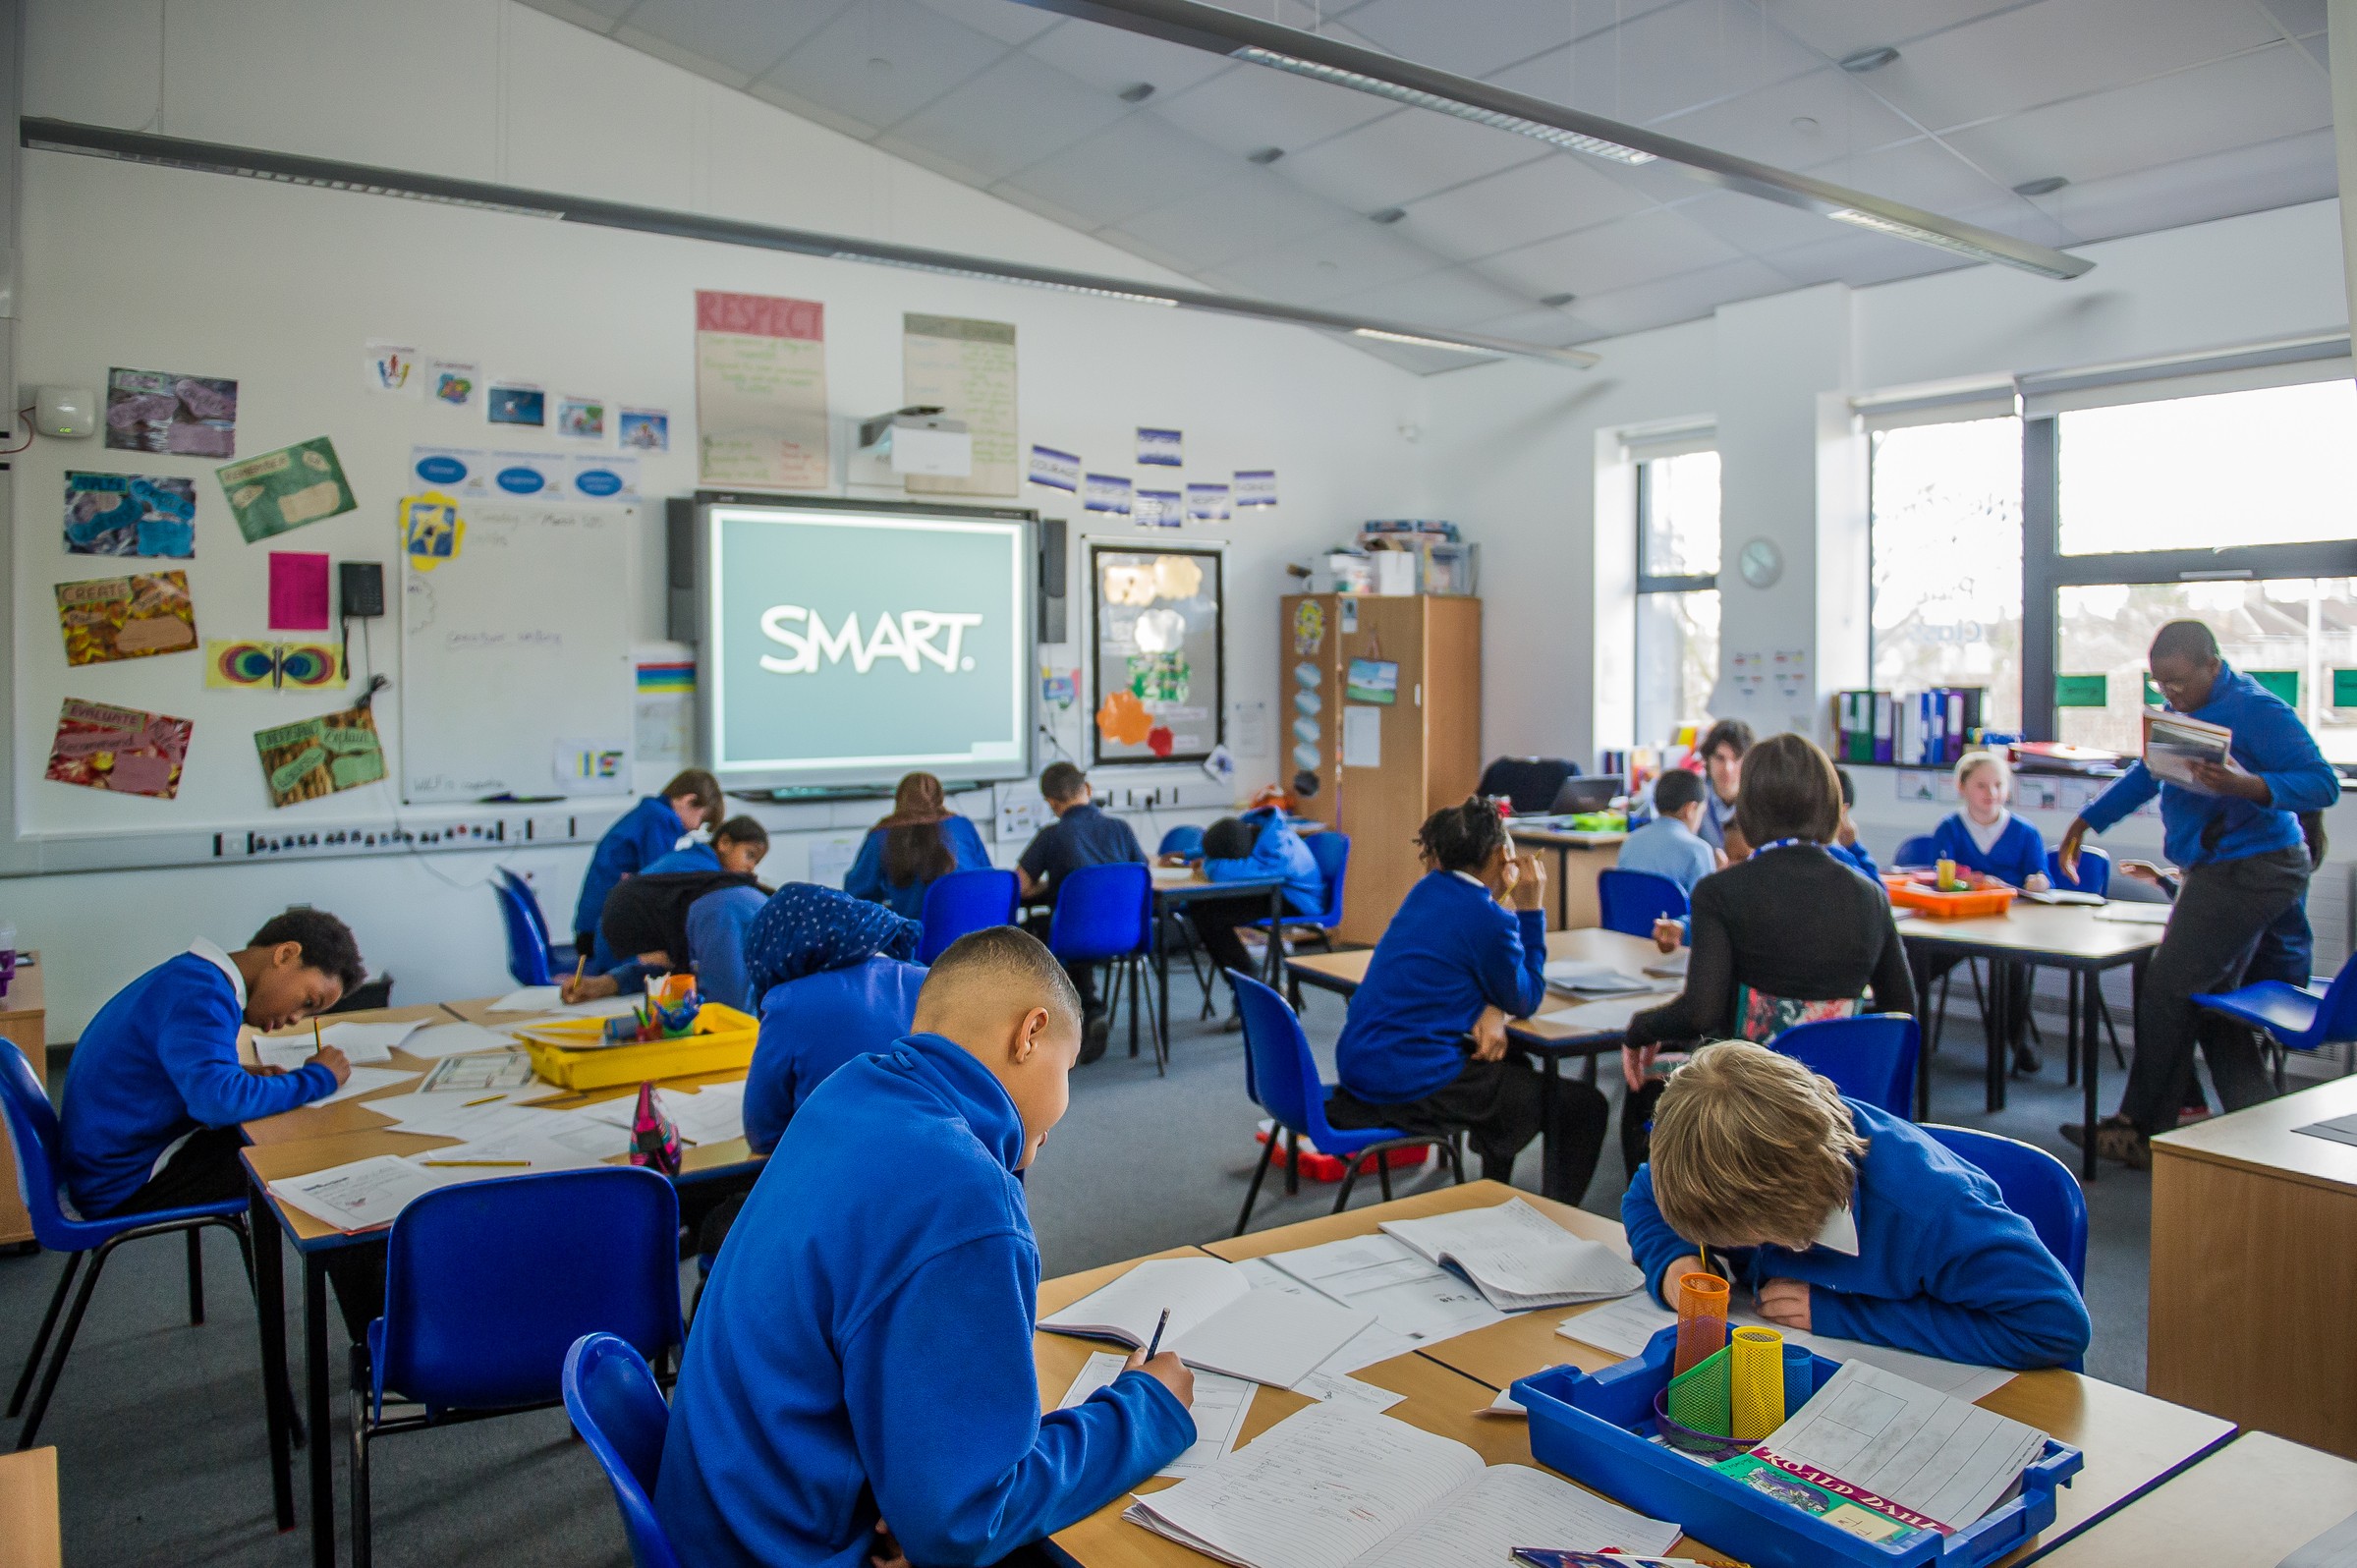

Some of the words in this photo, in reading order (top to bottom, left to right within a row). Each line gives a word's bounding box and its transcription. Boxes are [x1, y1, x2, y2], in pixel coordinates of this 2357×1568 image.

[697, 291, 823, 340] RESPECT
[63, 583, 129, 602] CREATE
[68, 703, 141, 726] EVALUATE
[57, 732, 135, 752] Recommend
[323, 727, 369, 752] Explain
[1762, 1447, 1854, 1495] ROALD
